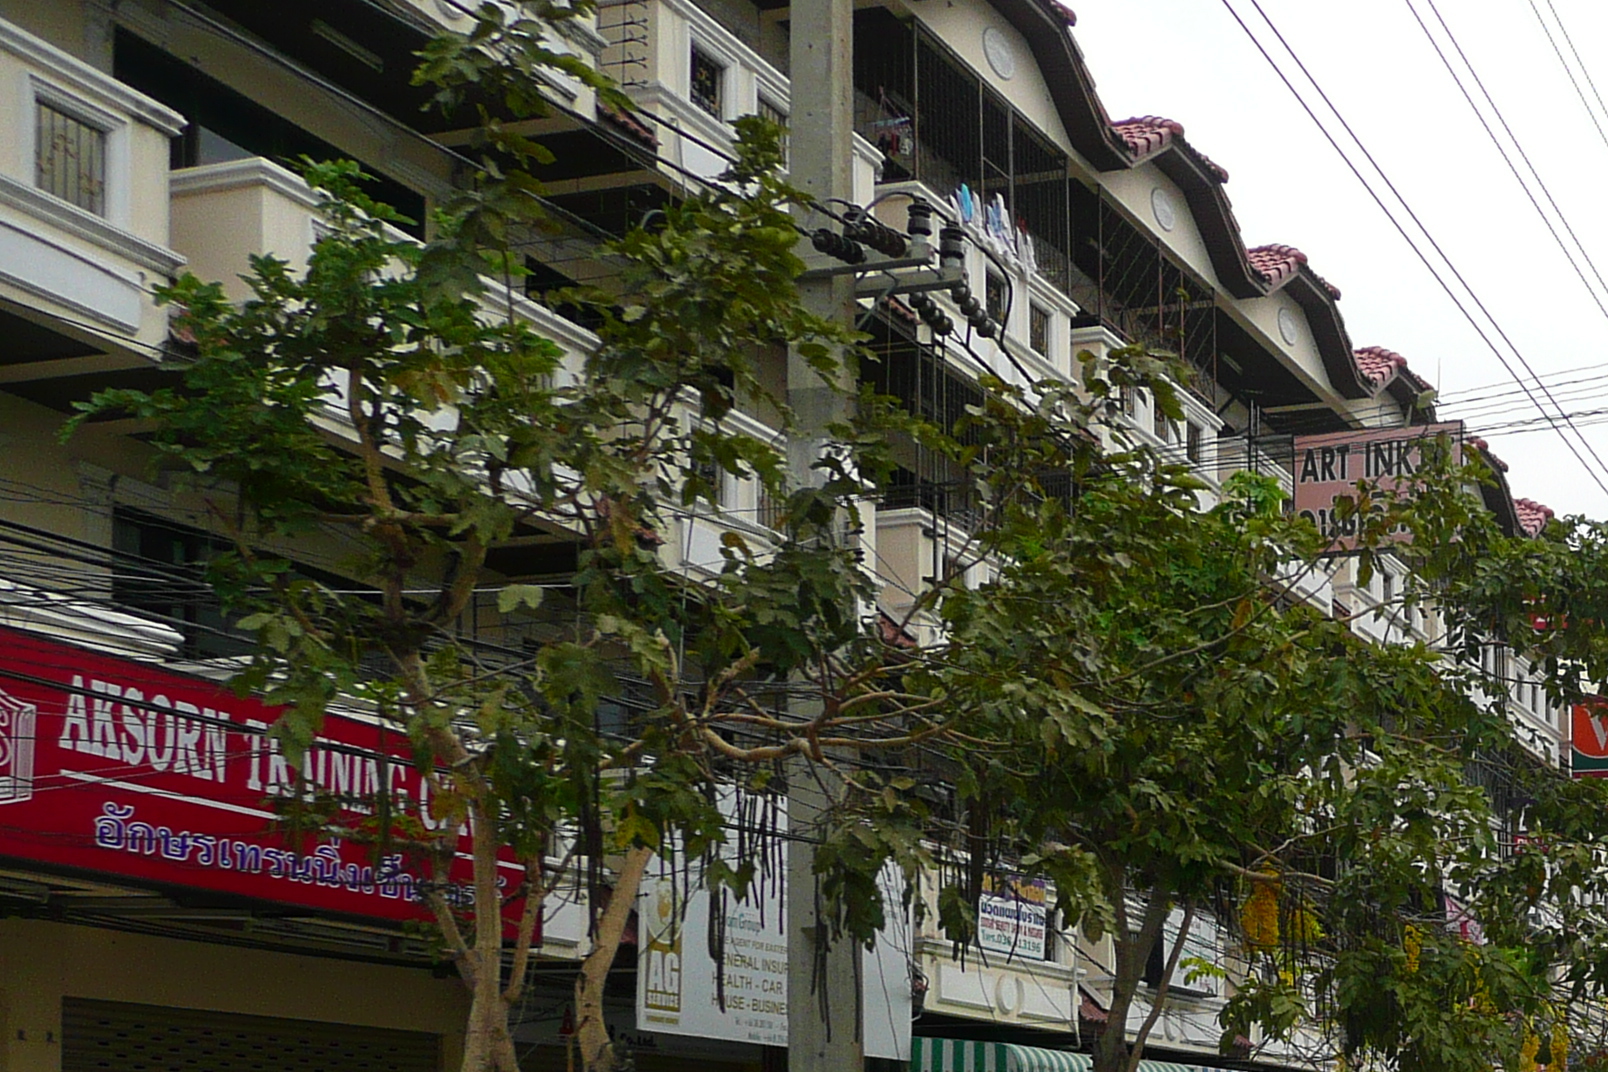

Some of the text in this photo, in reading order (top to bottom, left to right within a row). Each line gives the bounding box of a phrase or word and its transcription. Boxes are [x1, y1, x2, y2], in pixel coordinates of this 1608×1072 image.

[1301, 446, 1349, 482] ART
[58, 674, 230, 783] AKSORN
[722, 953, 759, 971] ENERAL
[711, 993, 745, 1010] HUSE
[751, 998, 788, 1016] BUSINE
